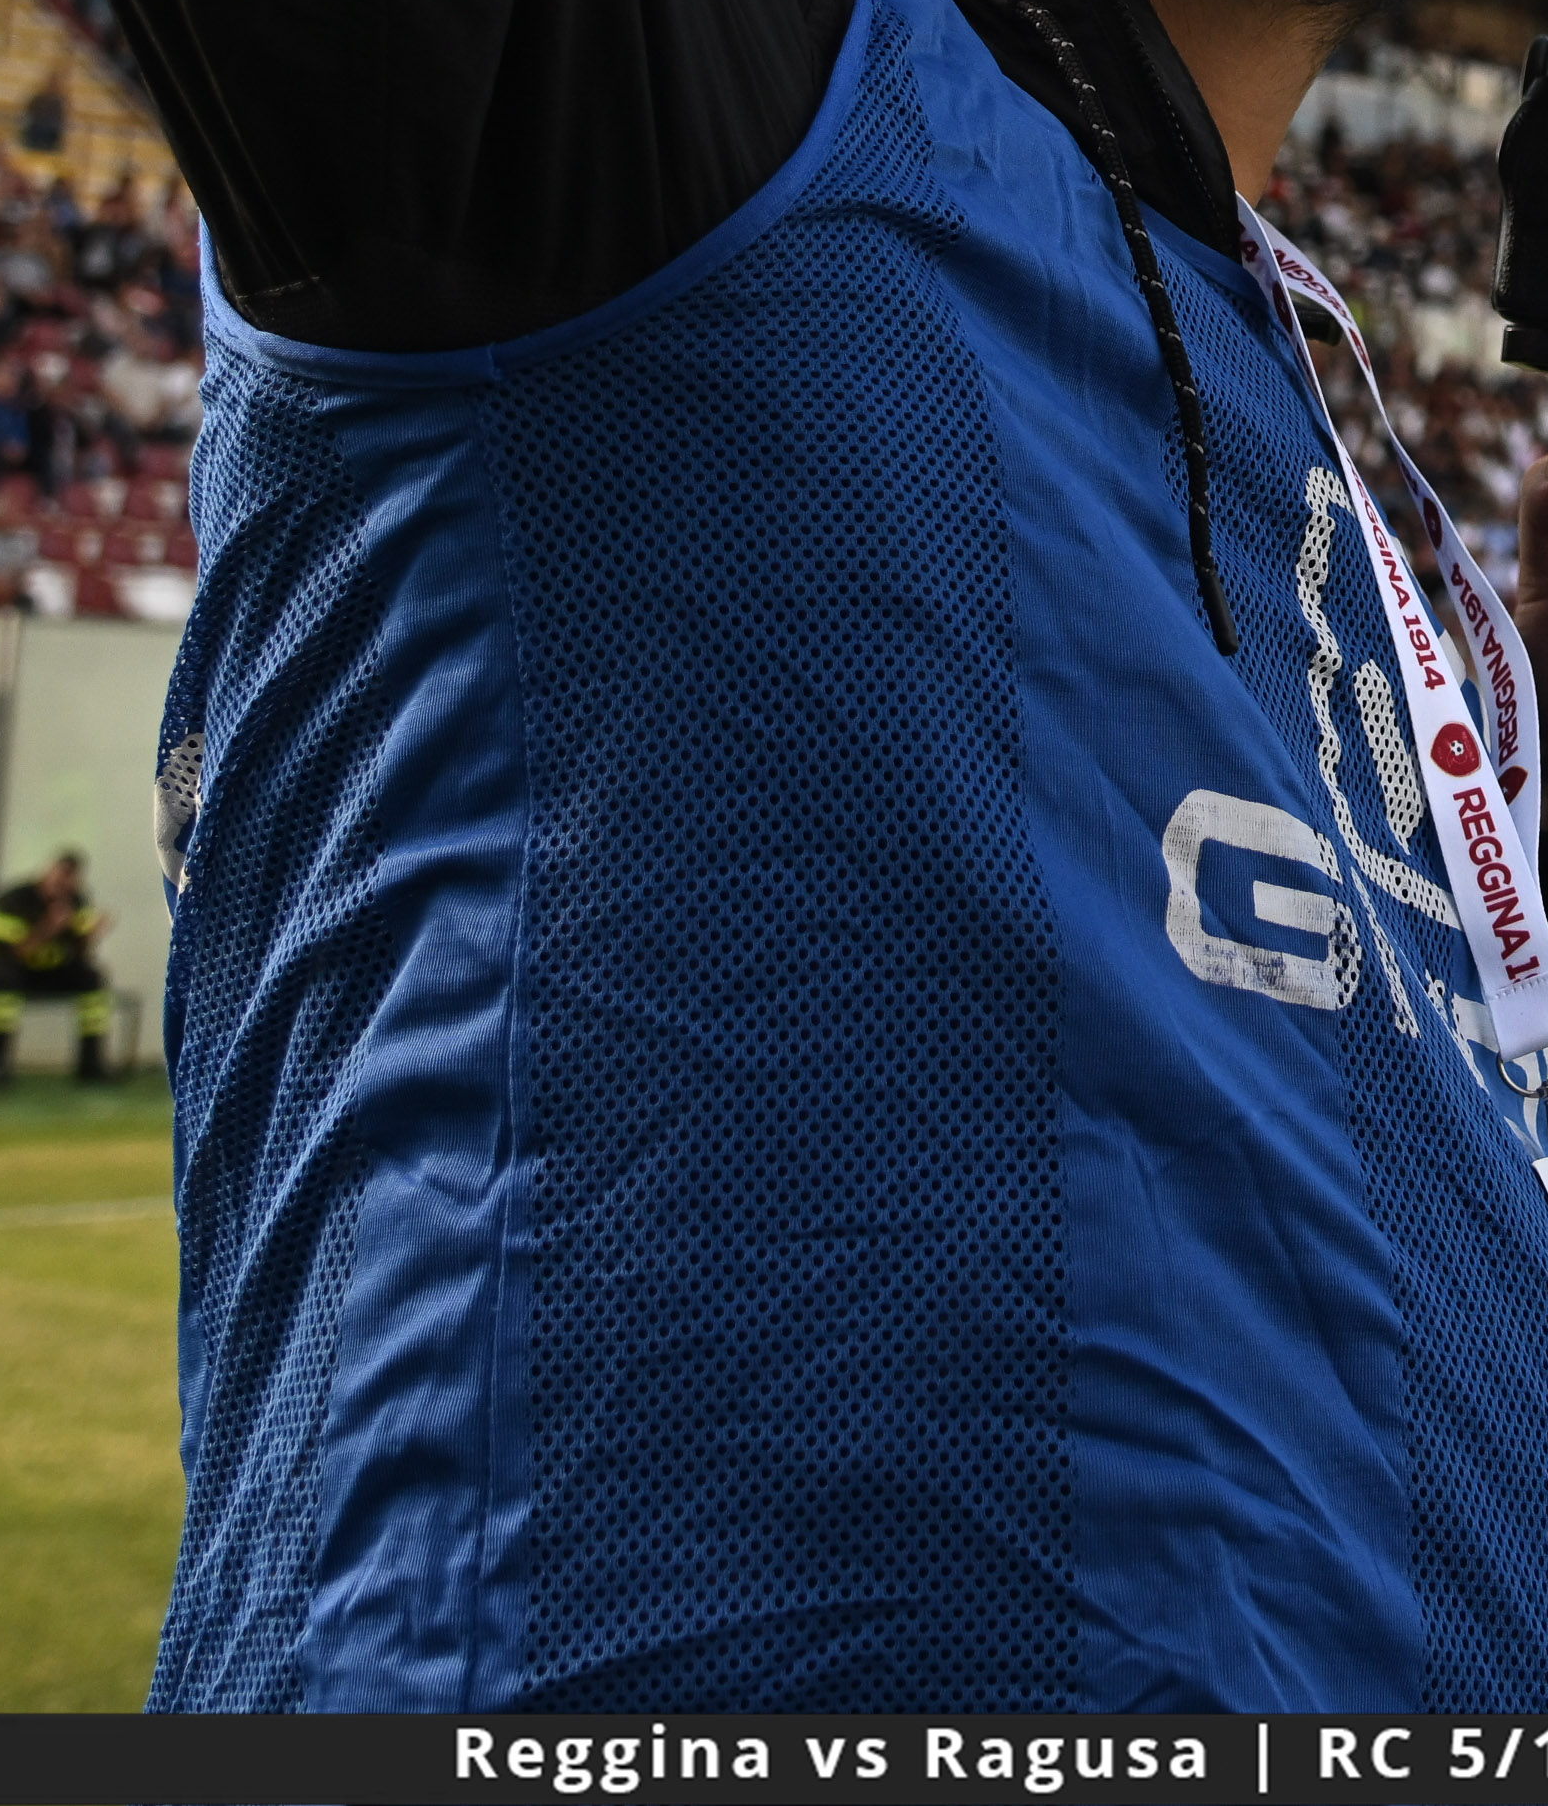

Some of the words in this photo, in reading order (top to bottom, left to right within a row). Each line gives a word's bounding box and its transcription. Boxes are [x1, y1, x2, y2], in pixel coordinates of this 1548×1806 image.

[1403, 614, 1447, 691] 1914
[1451, 562, 1489, 637] 1914
[1482, 624, 1519, 767] REGGINA
[1453, 786, 1532, 961] REGGINA
